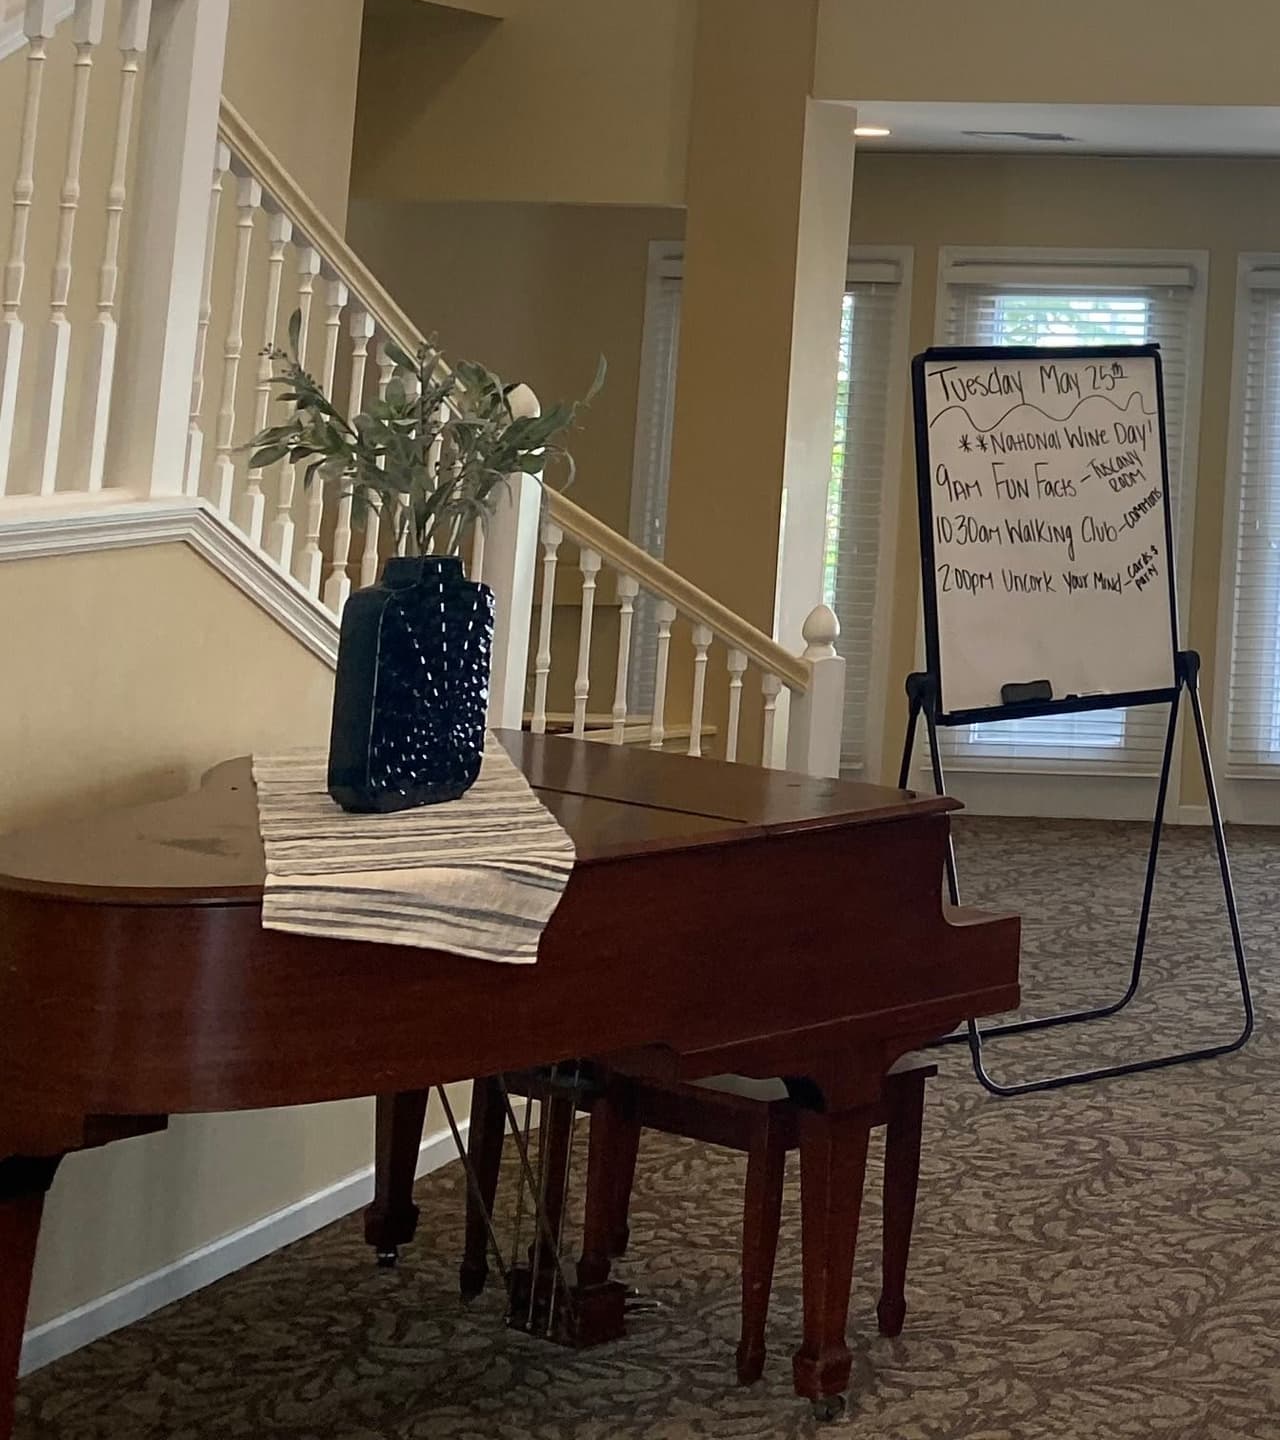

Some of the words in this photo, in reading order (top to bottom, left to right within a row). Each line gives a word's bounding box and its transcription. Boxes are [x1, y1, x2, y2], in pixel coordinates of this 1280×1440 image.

[928, 366, 1025, 404] Tuesday
[1040, 364, 1081, 398] May
[1085, 361, 1128, 391] 25th
[1034, 462, 1077, 500] Facts
[1005, 518, 1075, 561] Walking
[1081, 515, 1118, 543] Club
[1001, 568, 1057, 593] Uncork
